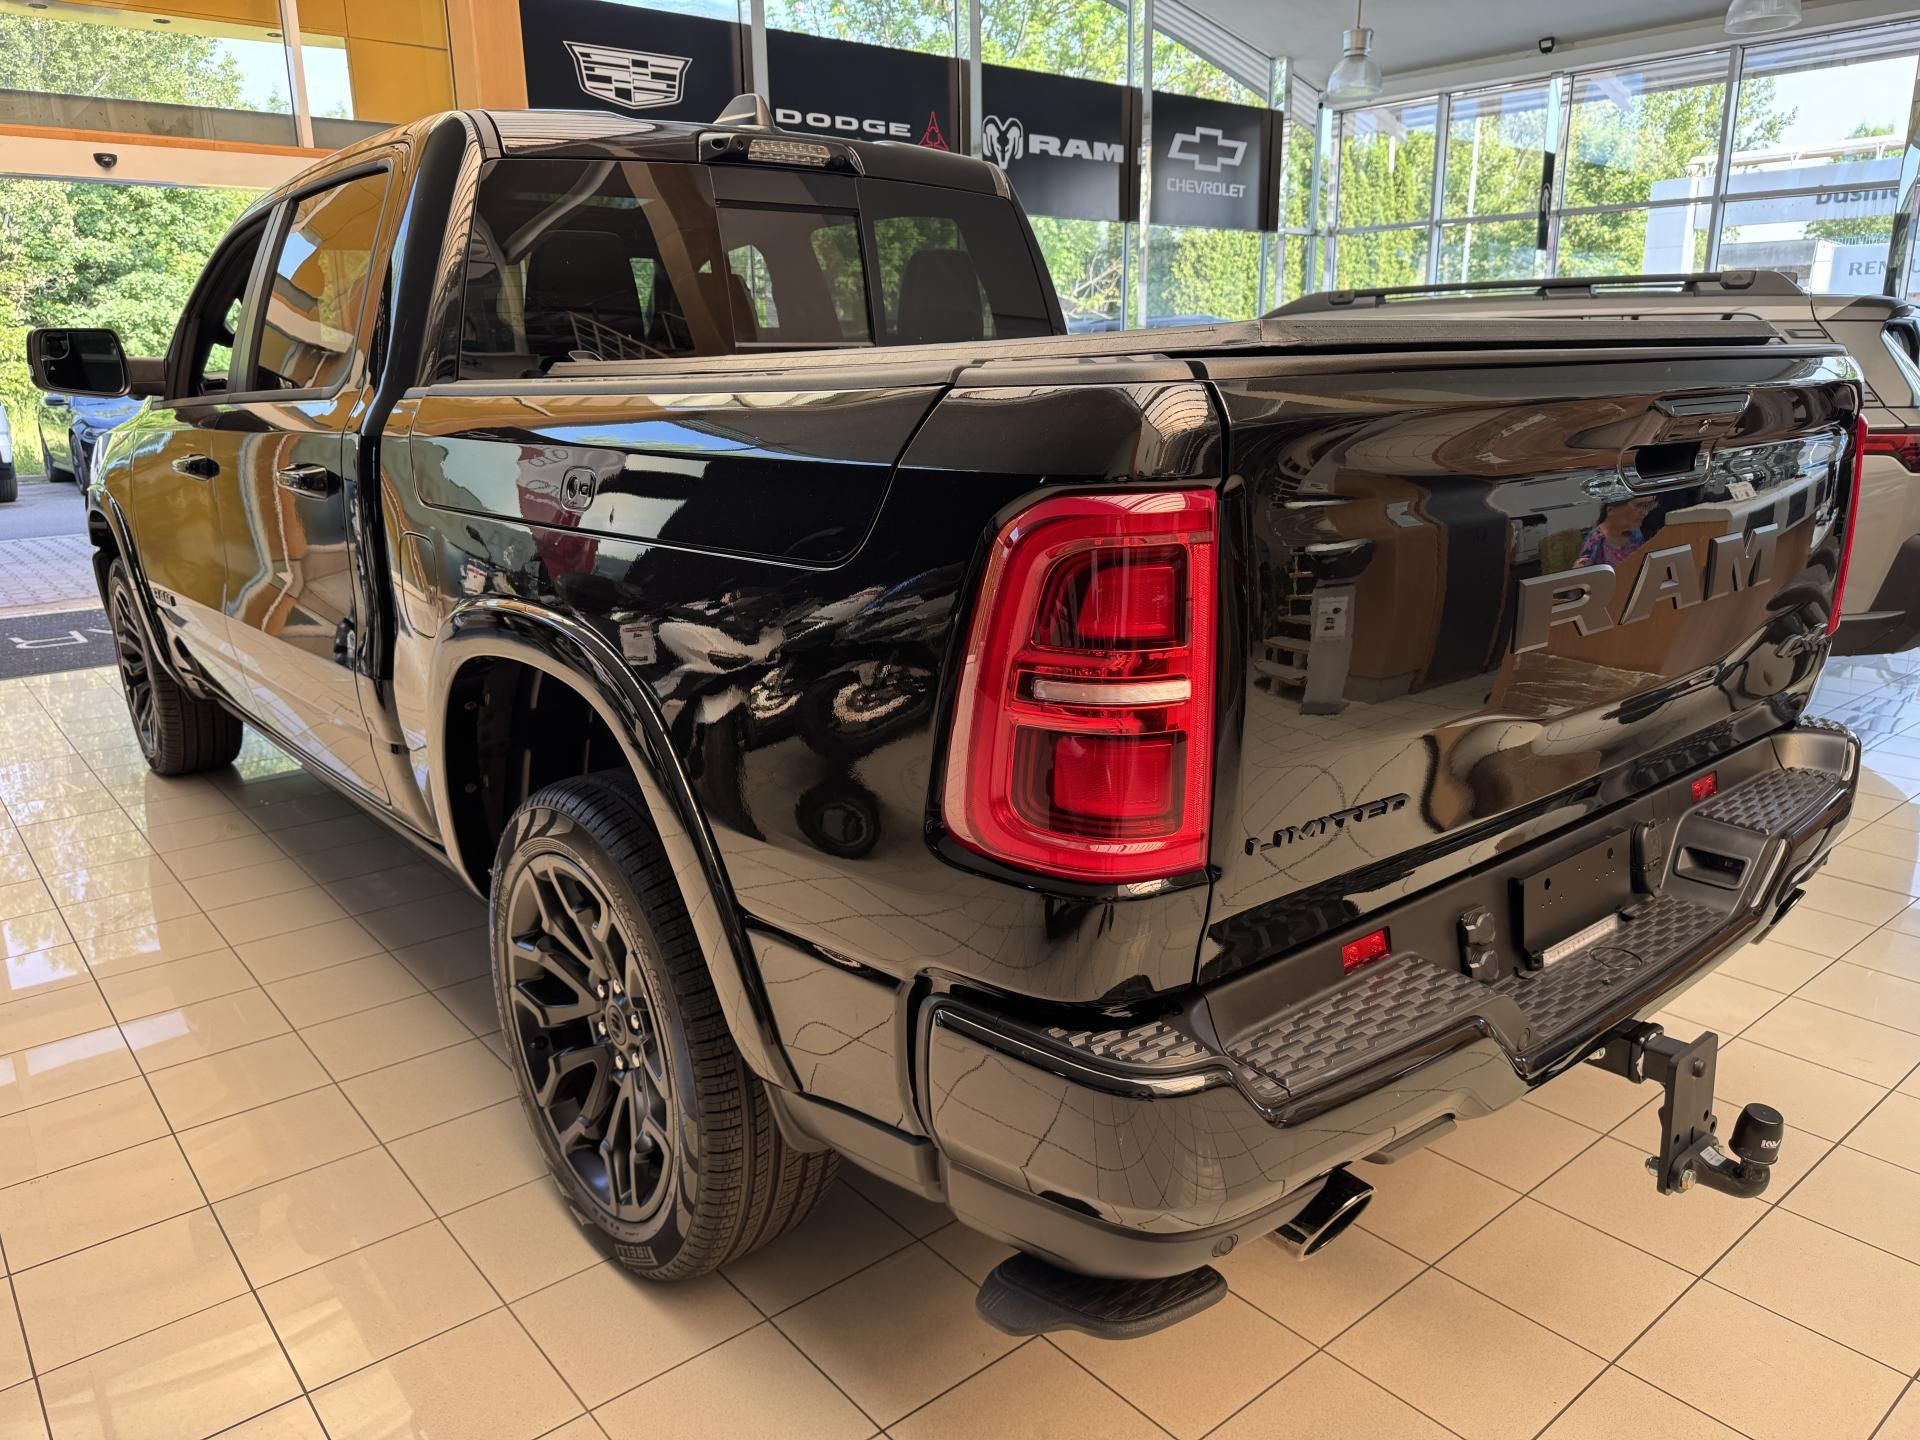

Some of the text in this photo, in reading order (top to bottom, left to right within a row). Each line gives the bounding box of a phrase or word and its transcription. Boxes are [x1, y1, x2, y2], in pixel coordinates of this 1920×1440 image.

[775, 108, 911, 137] DODGE
[1029, 134, 1125, 163] RAM
[1166, 177, 1246, 198] CHEVROLET
[1510, 522, 1779, 655] RAM
[1244, 792, 1412, 856] LIMITED
